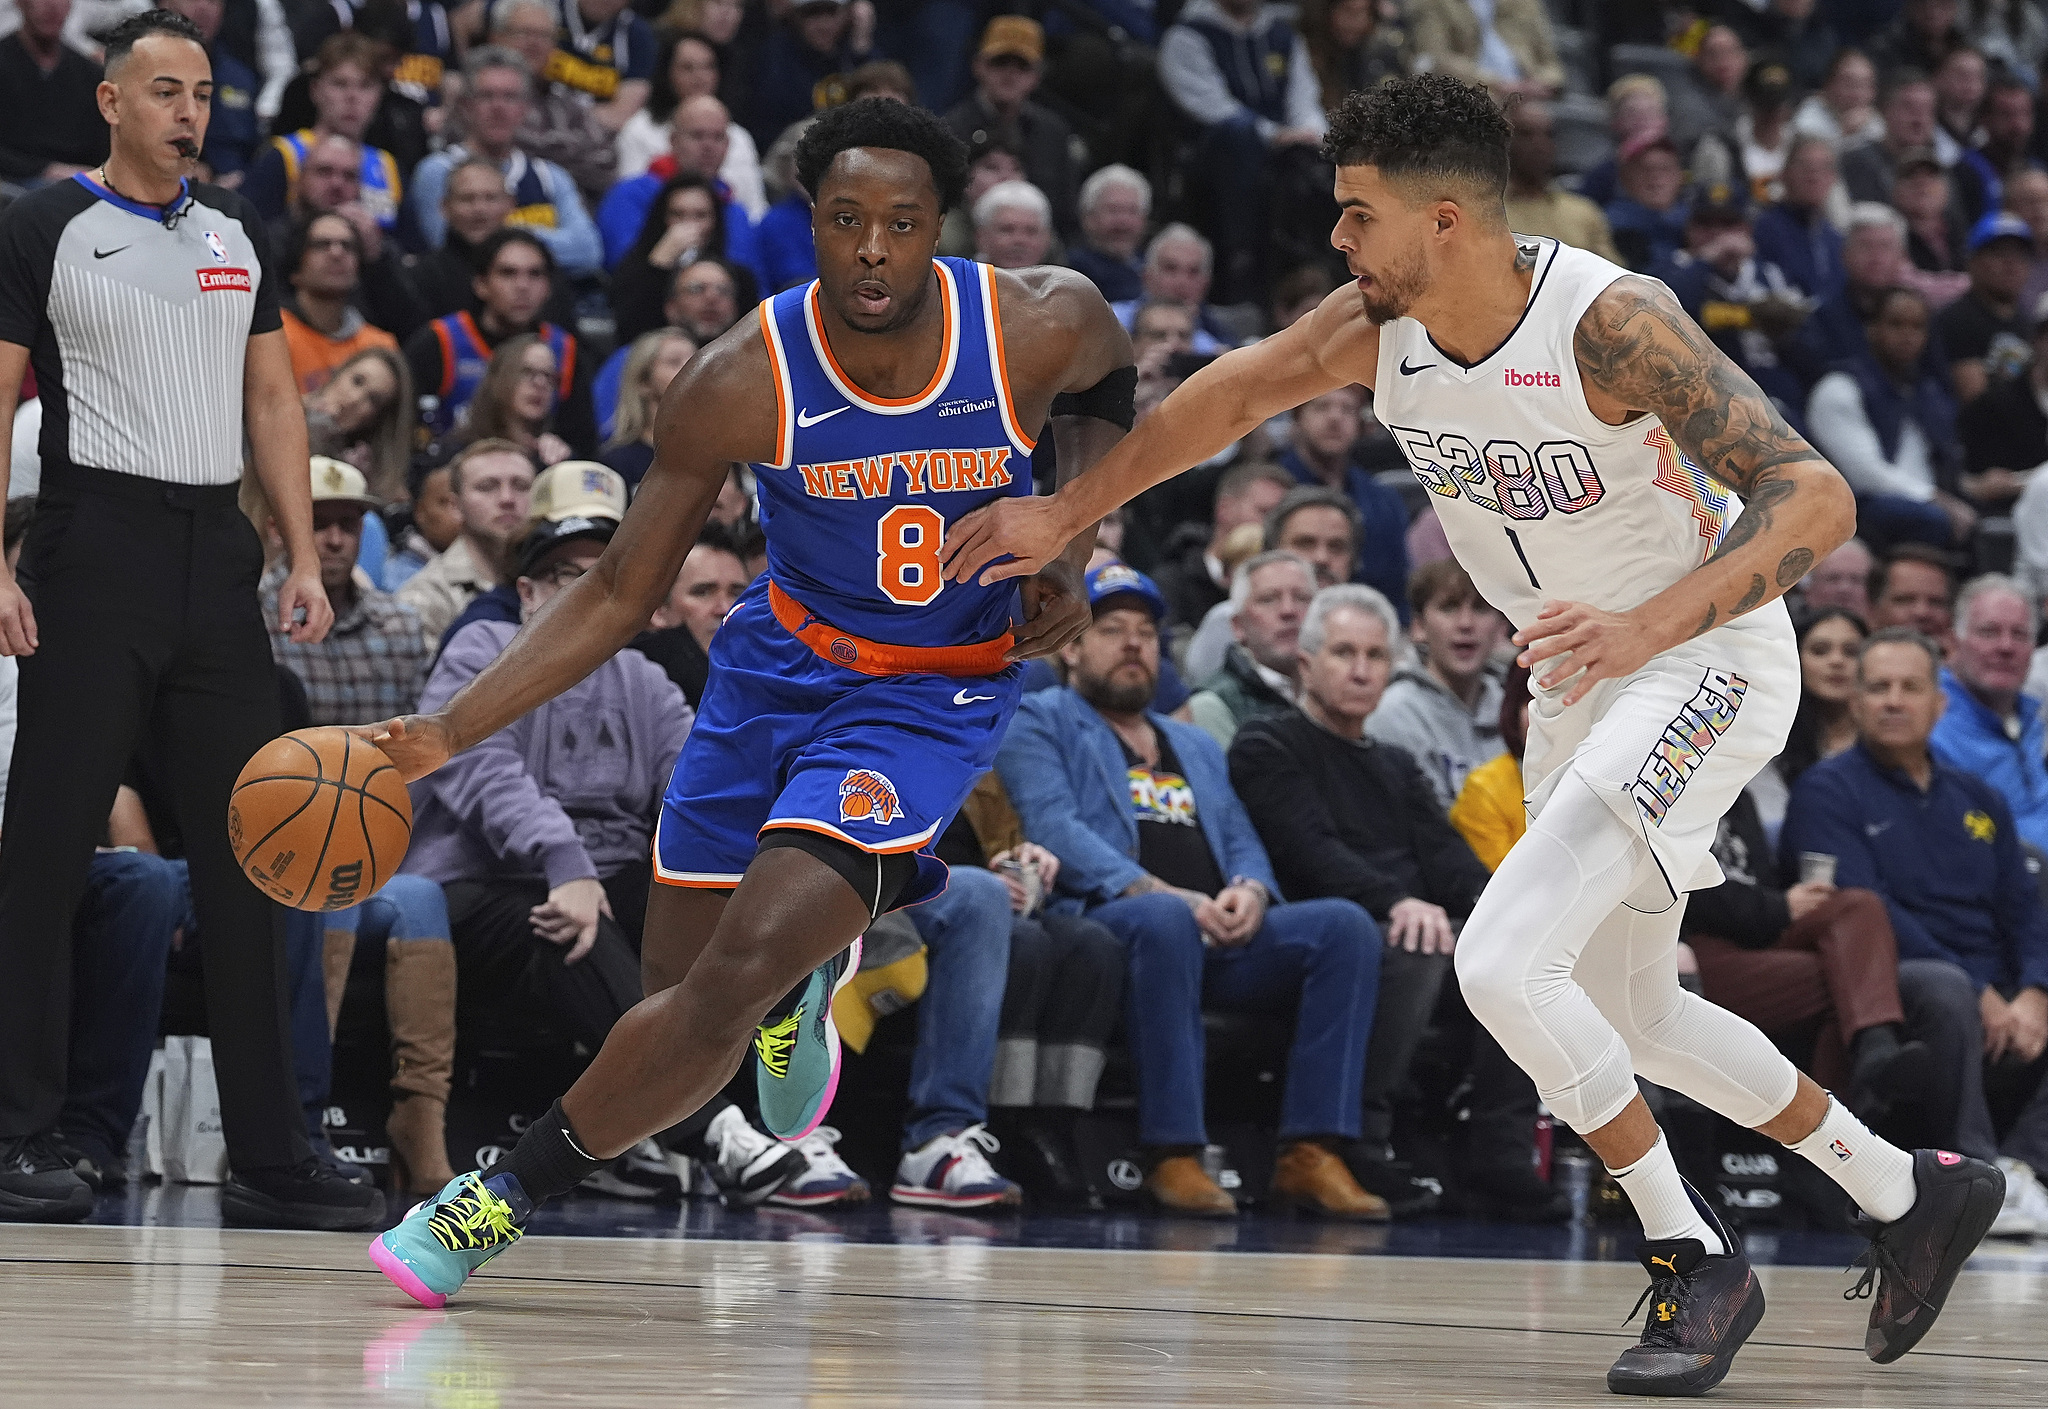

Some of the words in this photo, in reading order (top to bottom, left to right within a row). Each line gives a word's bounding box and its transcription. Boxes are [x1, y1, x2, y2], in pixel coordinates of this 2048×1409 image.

[198, 271, 251, 288] Emirates
[1504, 368, 1561, 388] ibotta
[938, 406, 961, 418] abu
[963, 397, 996, 414] dhabi
[797, 453, 895, 500] NEW
[896, 446, 1014, 495] YORK
[1389, 424, 1607, 520] 5280
[877, 504, 946, 607] 8
[1504, 525, 1542, 590] 1
[1630, 667, 1749, 829] DENVER
[842, 771, 897, 822] KNICKS
